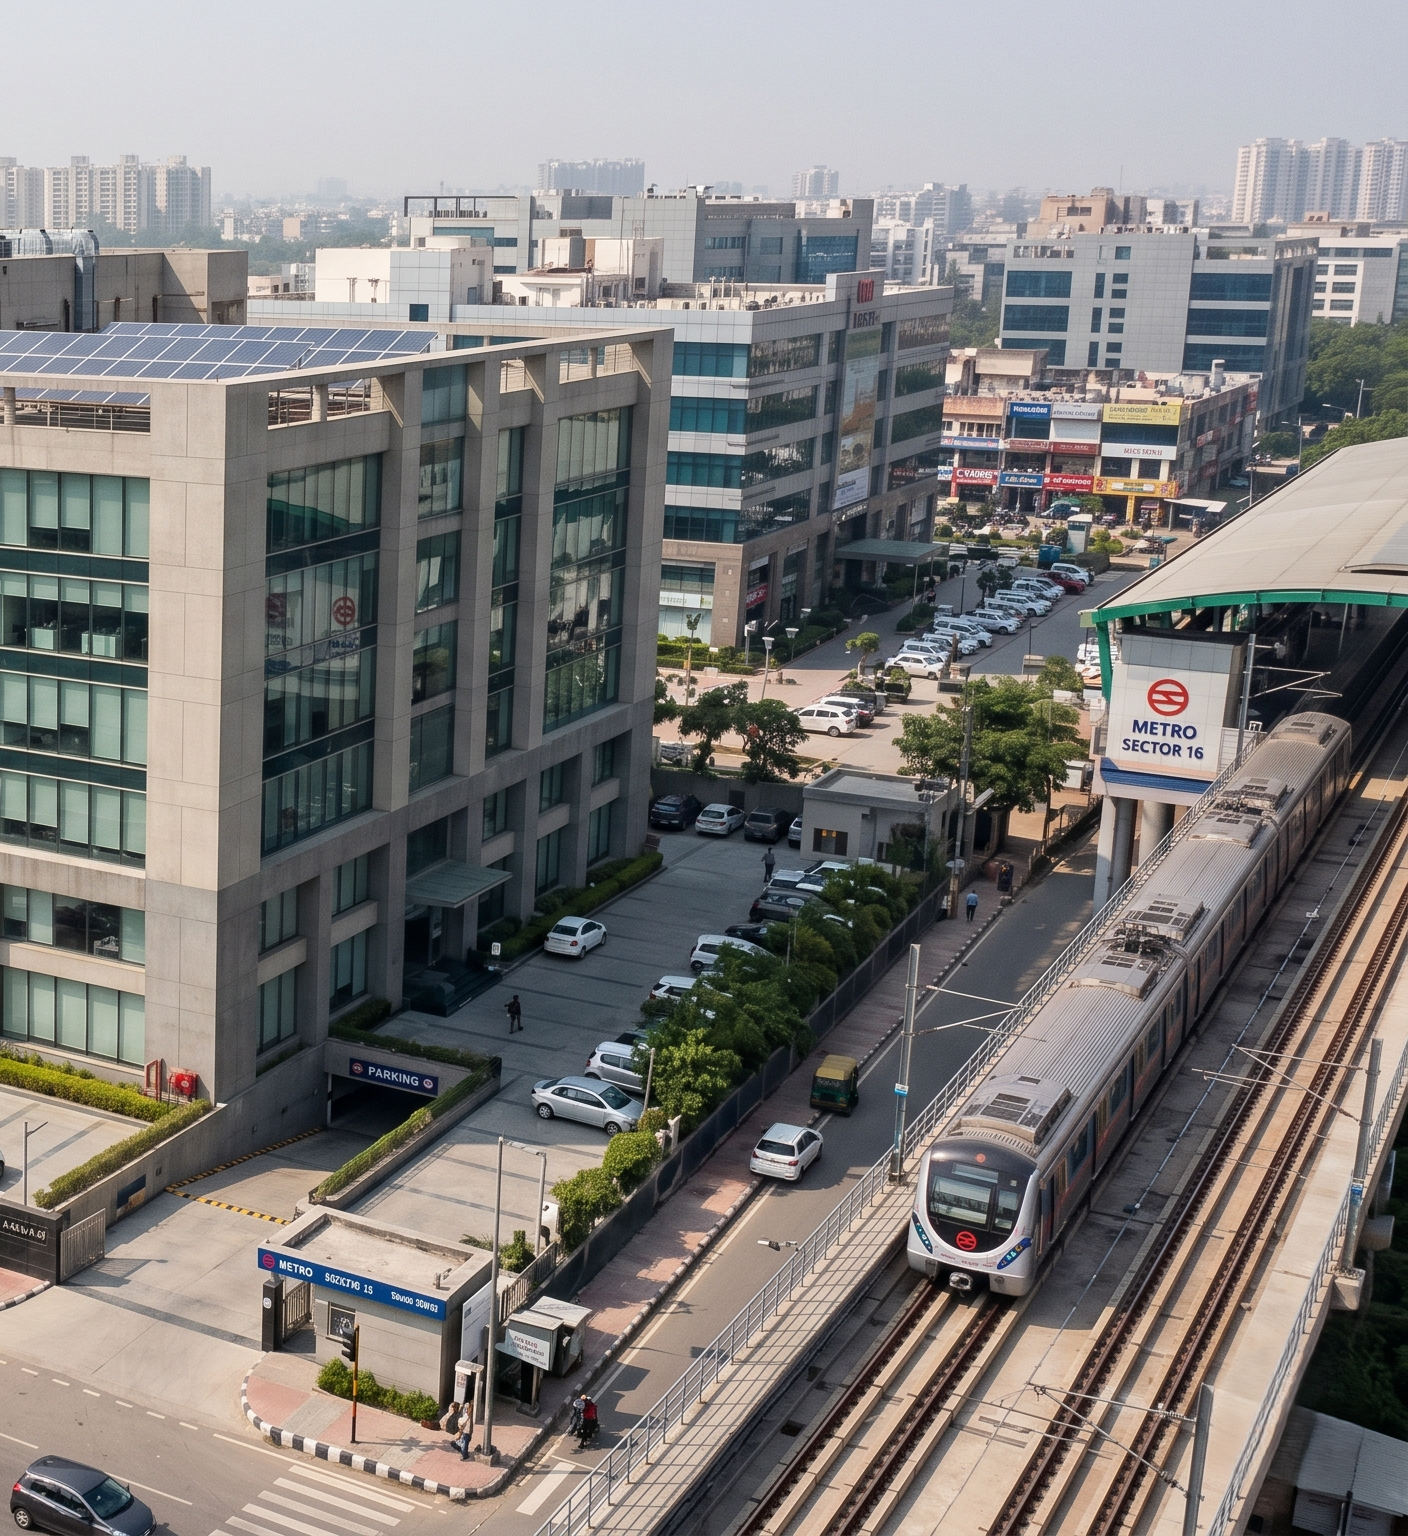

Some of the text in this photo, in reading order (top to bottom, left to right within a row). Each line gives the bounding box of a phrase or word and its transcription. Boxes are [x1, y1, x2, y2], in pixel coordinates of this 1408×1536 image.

[1132, 719, 1197, 740] METRO
[1122, 738, 1204, 760] SECTOR 16
[368, 1066, 419, 1087] PARKING
[279, 1259, 313, 1278] METRO
